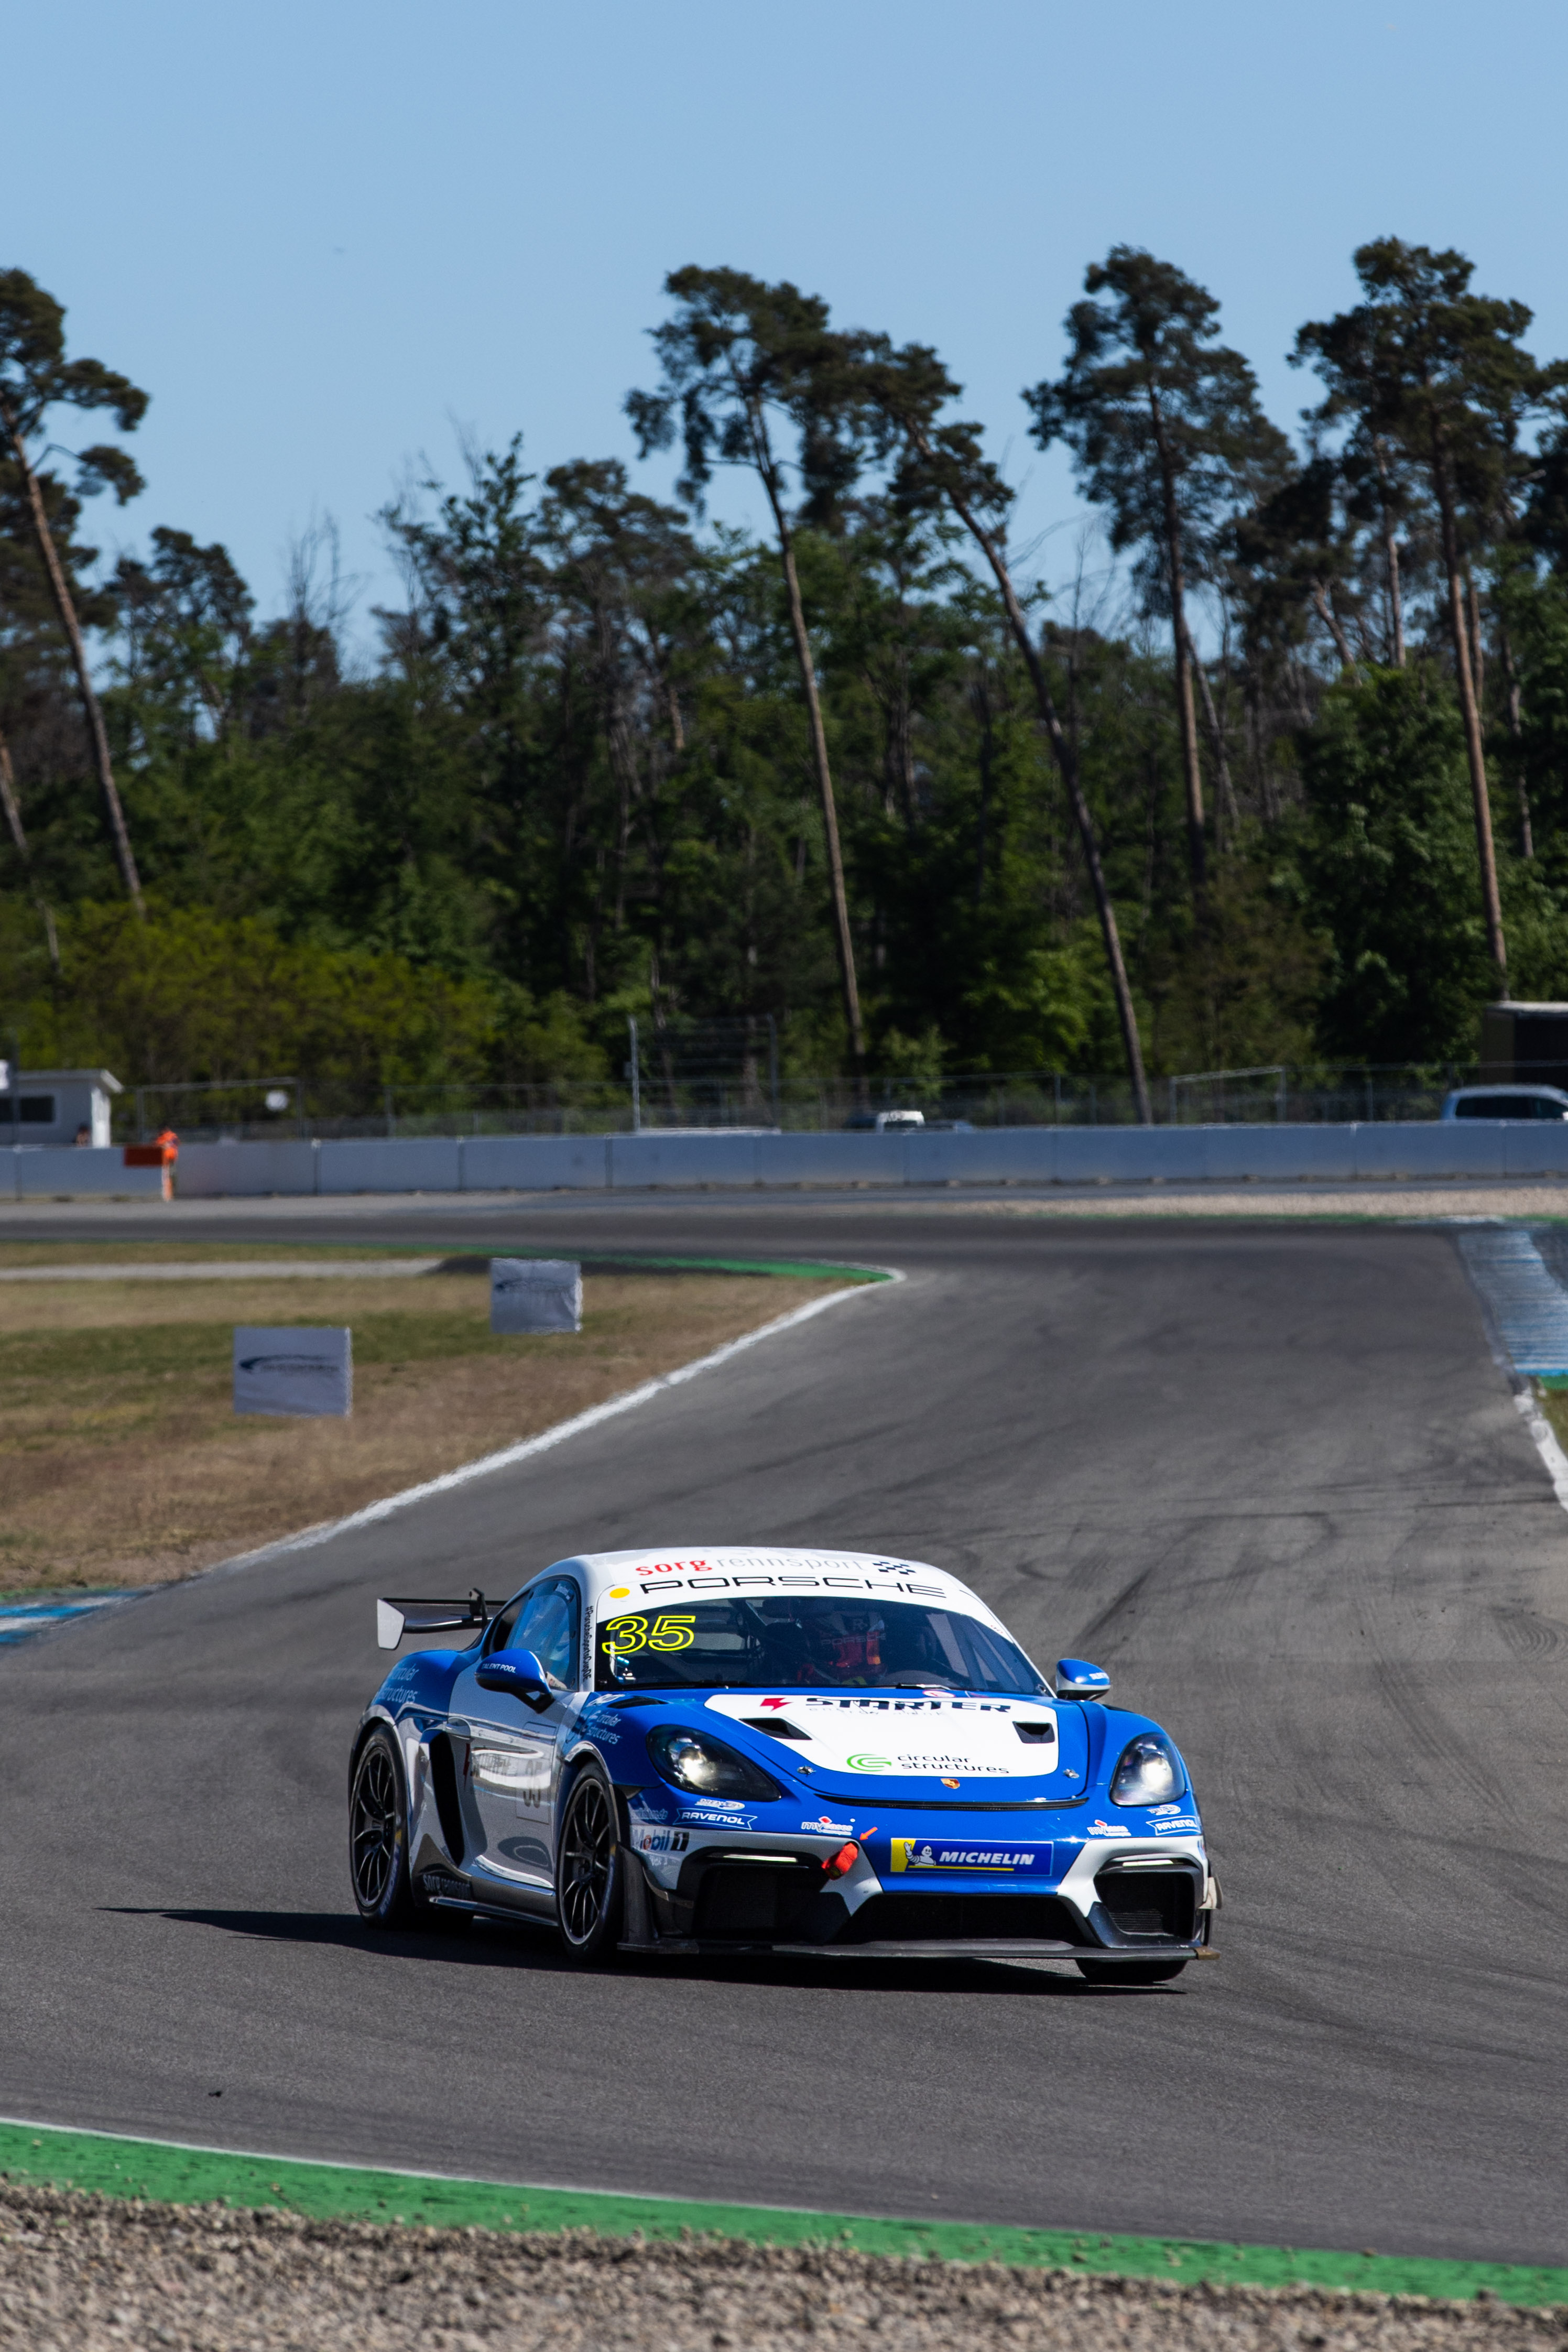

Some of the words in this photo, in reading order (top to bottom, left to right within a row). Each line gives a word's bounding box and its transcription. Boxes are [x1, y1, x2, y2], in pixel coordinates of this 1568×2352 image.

[635, 1560, 713, 1575] sorg
[716, 1557, 866, 1571] rennsport
[639, 1576, 947, 1598] PORSCHE
[602, 1615, 696, 1654] 35
[500, 1663, 517, 1673] POOL
[805, 1697, 1011, 1713] STARTER
[897, 1754, 971, 1763] circular
[901, 1762, 1010, 1774] structures
[681, 1812, 746, 1825] RAVENOL
[1155, 1819, 1198, 1831] RAVENOL
[939, 1851, 1036, 1865] MICHELIN
